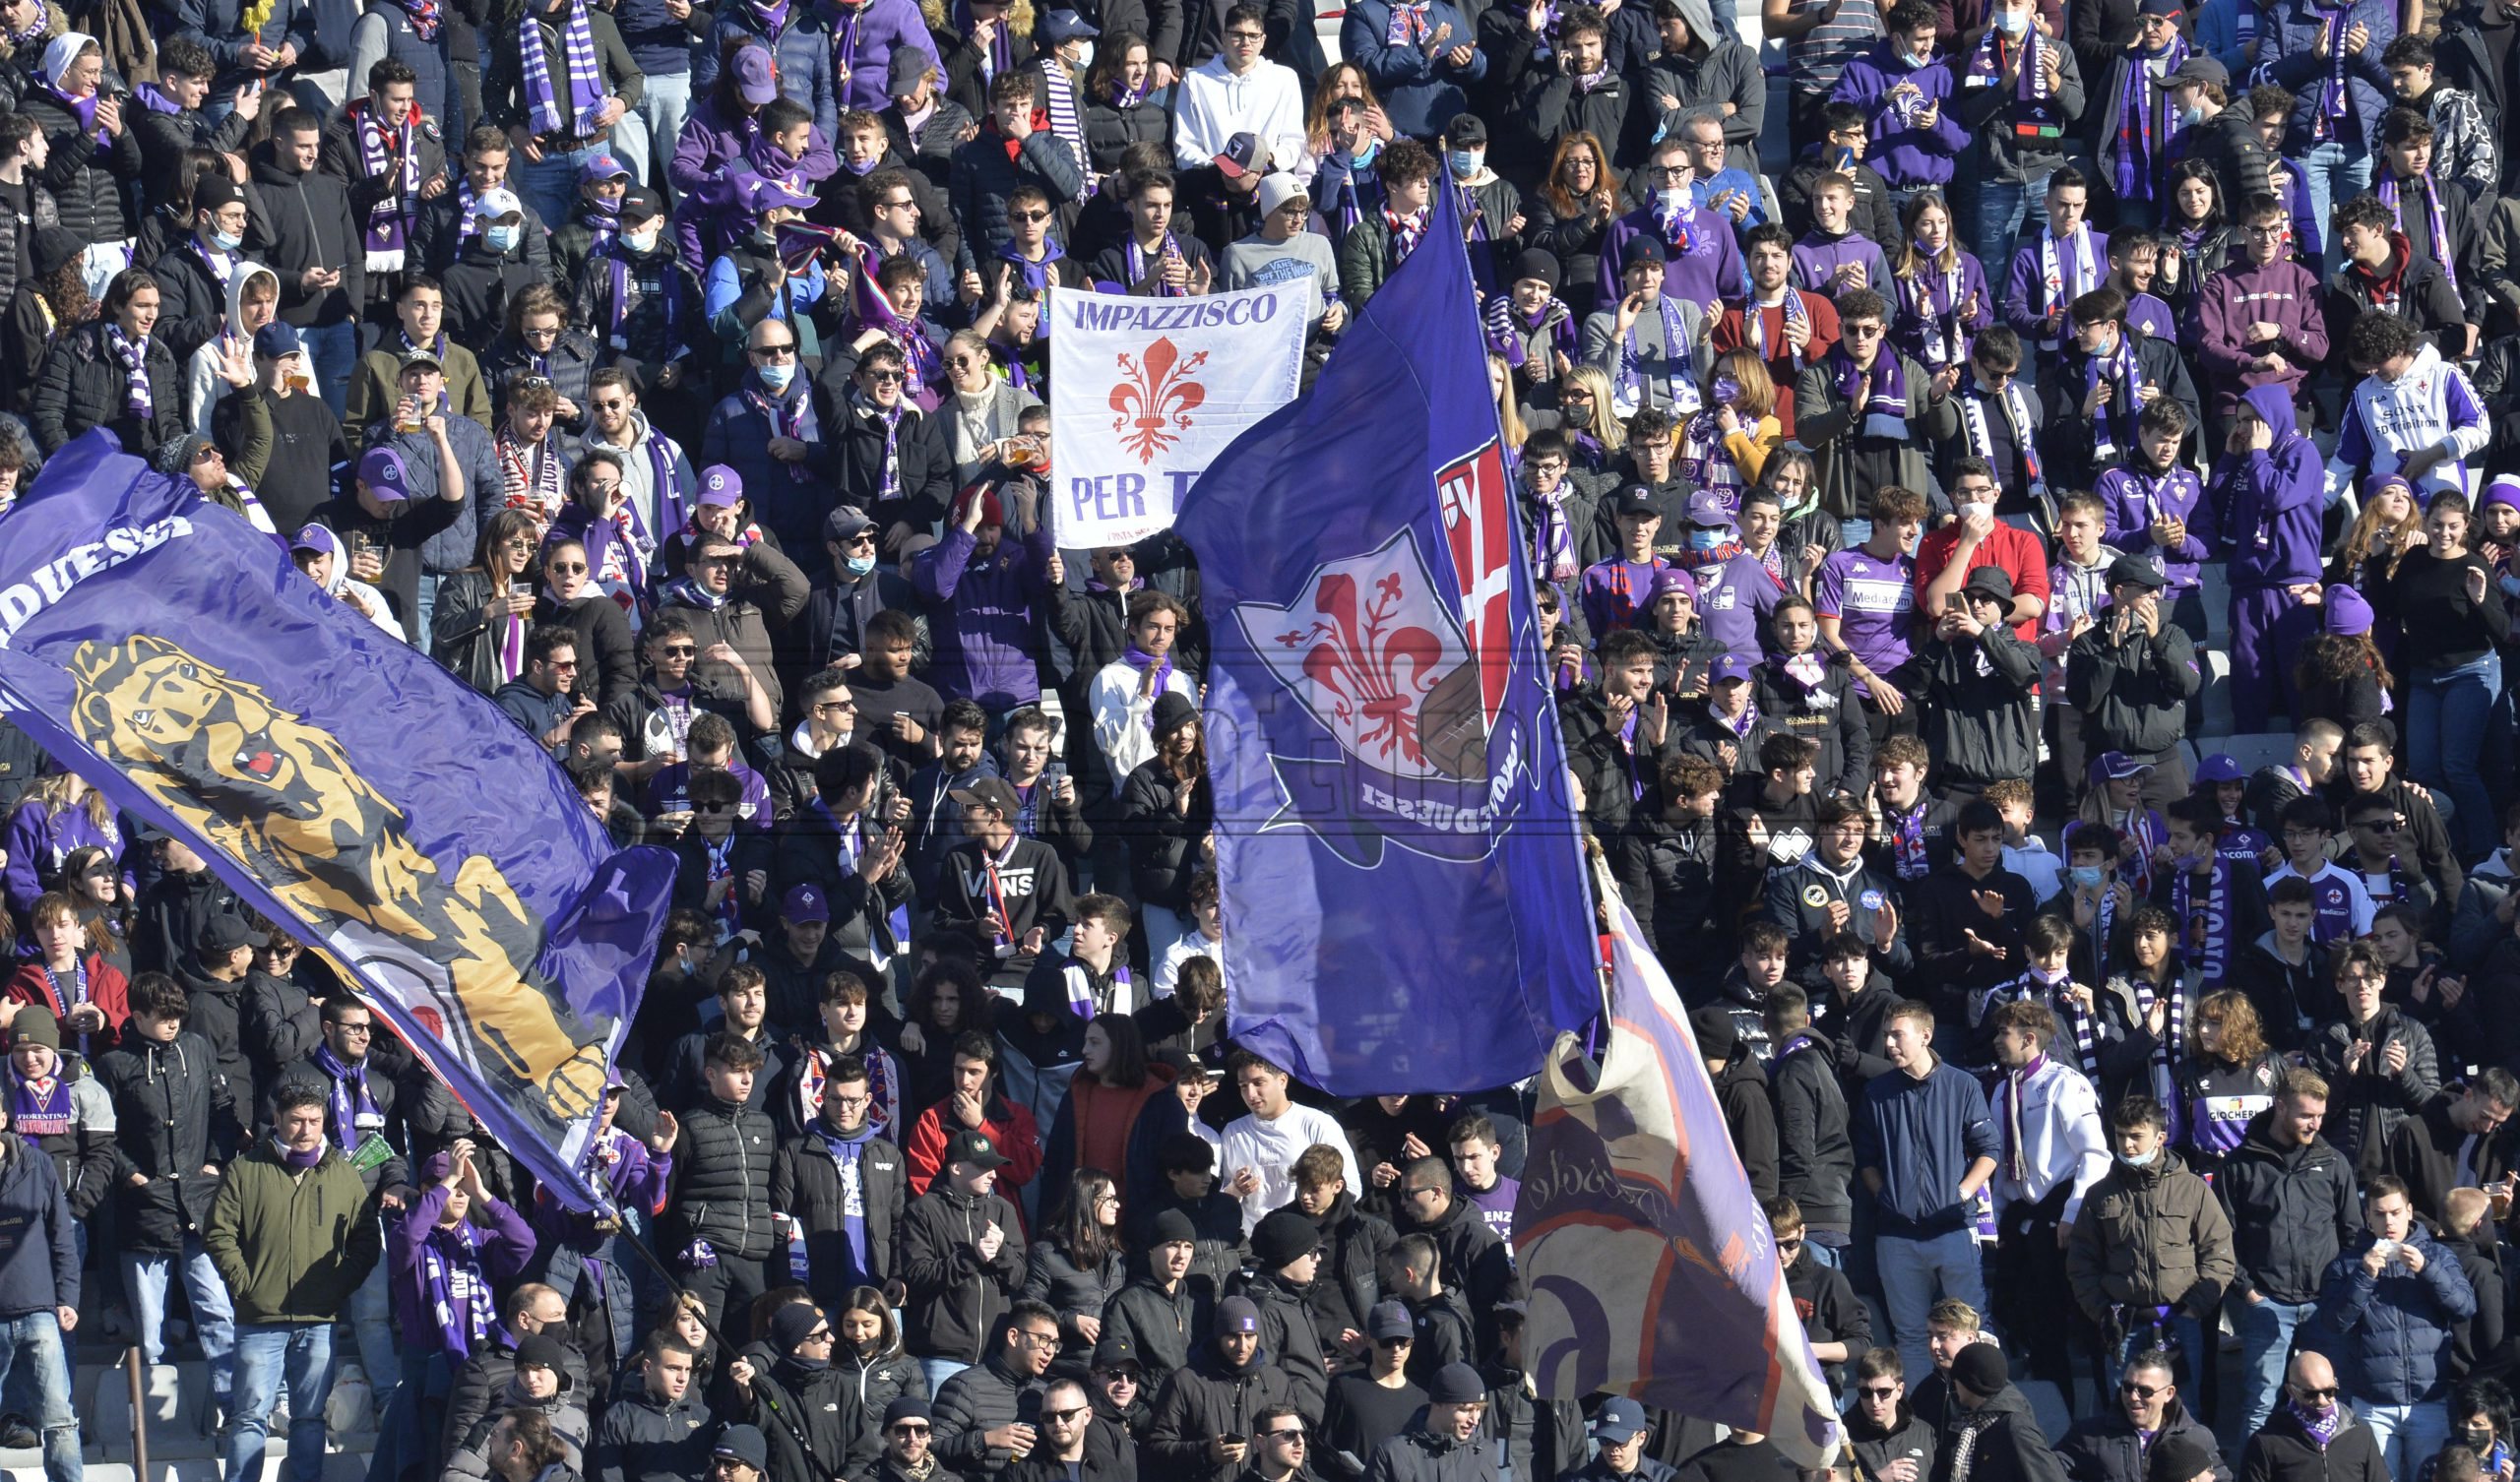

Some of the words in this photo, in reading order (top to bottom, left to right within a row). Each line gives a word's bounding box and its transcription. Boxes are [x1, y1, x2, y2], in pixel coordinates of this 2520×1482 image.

[1269, 259, 1293, 271] VANS
[1276, 268, 1292, 280] THE
[1075, 293, 1278, 332] IMPAZZISCO
[2383, 404, 2426, 420] SONY
[2375, 425, 2389, 437] FD
[2390, 417, 2439, 434] Trinitron
[1071, 472, 1147, 522] PER
[1163, 470, 1204, 515] T
[1853, 591, 1910, 607] Mediacom
